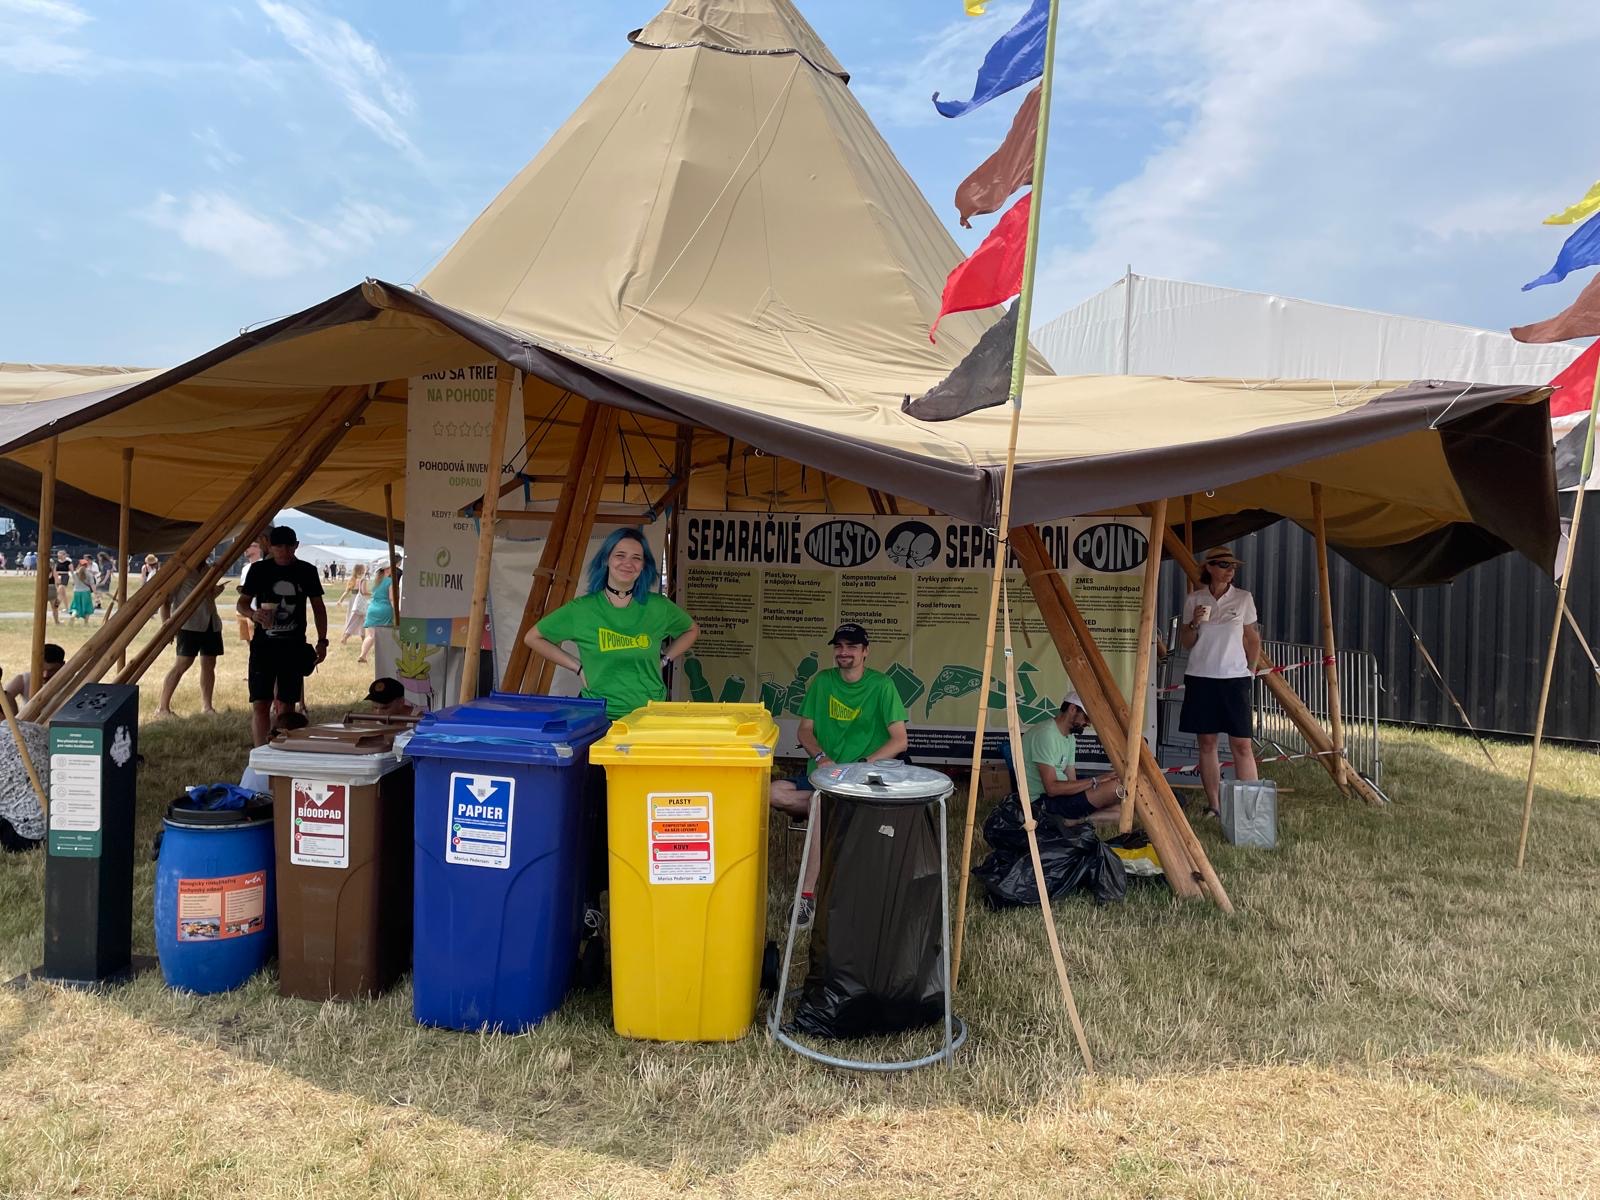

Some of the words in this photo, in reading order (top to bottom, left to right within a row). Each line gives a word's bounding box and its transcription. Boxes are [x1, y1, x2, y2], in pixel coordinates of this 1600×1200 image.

[468, 365, 497, 379] TRIE
[427, 388, 443, 402] NA
[446, 388, 494, 402] POHODE
[418, 459, 465, 472] POHODOVÁ
[466, 463, 515, 474] INVENRA
[448, 477, 482, 487] ODPADU
[431, 510, 452, 518] KEDY?
[453, 523, 469, 531] KDE?
[687, 513, 801, 564] SEPARAČNÉ
[808, 521, 877, 564] MIESTO
[1078, 526, 1147, 570] POINT
[419, 570, 464, 591] ENVIPAK
[769, 578, 796, 586] nápojové
[797, 579, 821, 587] kartóny
[917, 575, 940, 583] Zvyšky
[763, 607, 786, 615] Plastic,
[722, 616, 749, 624] beverage
[601, 631, 606, 649] V
[607, 631, 635, 649] POHODE
[298, 807, 341, 819] BIOODPAD
[458, 803, 503, 820] PAPIER
